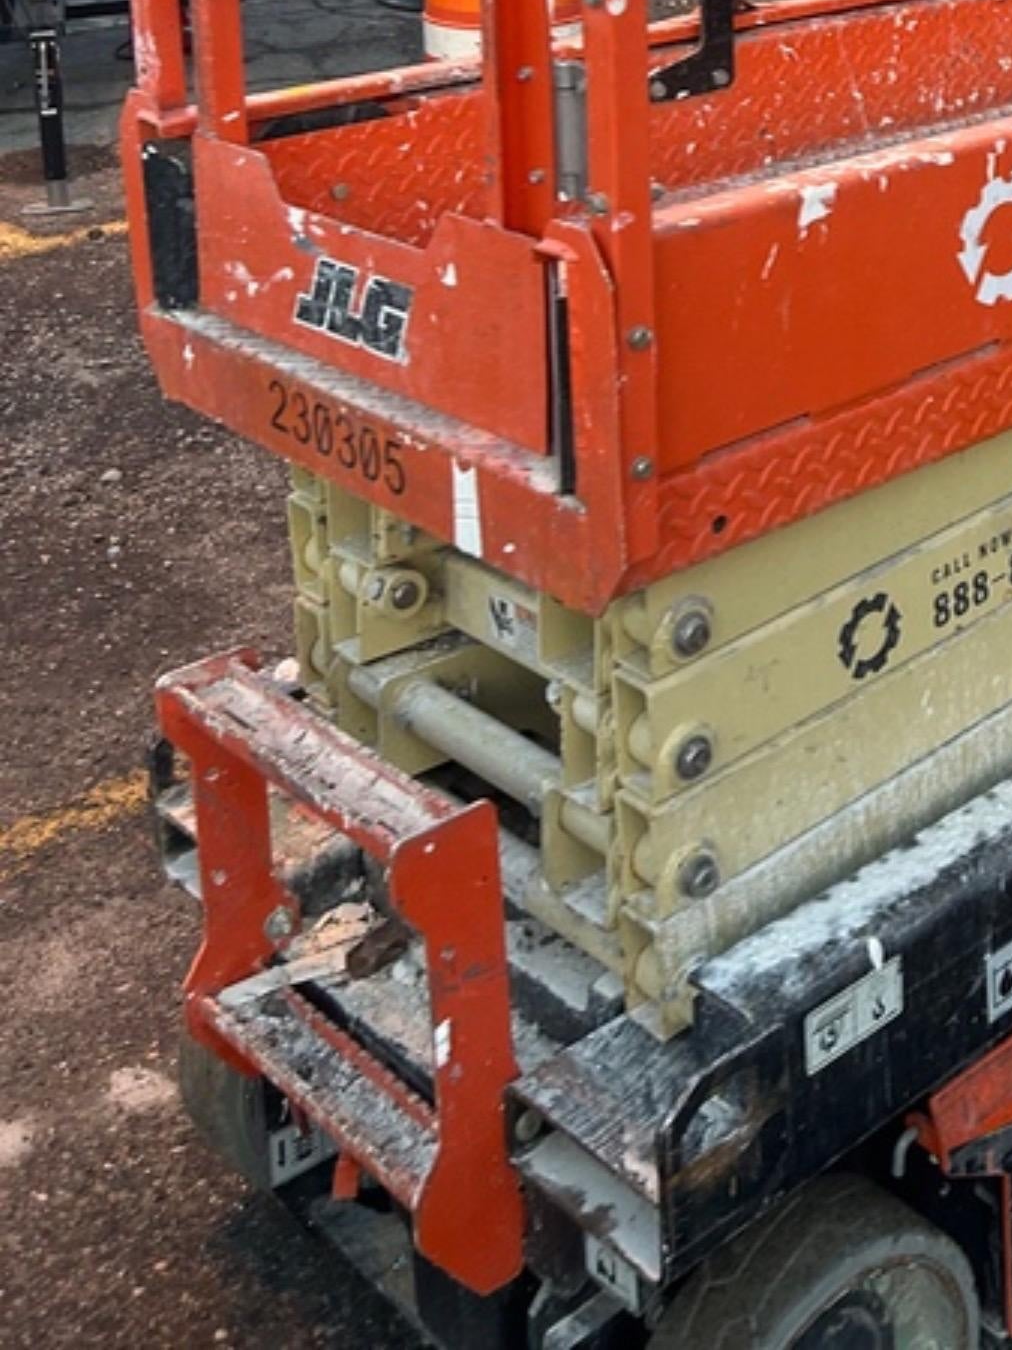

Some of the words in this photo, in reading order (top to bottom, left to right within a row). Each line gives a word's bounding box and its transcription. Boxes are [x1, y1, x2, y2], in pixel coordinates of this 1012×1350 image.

[294, 257, 415, 365] JLG
[268, 380, 407, 496] 230305
[931, 553, 971, 585] CALL
